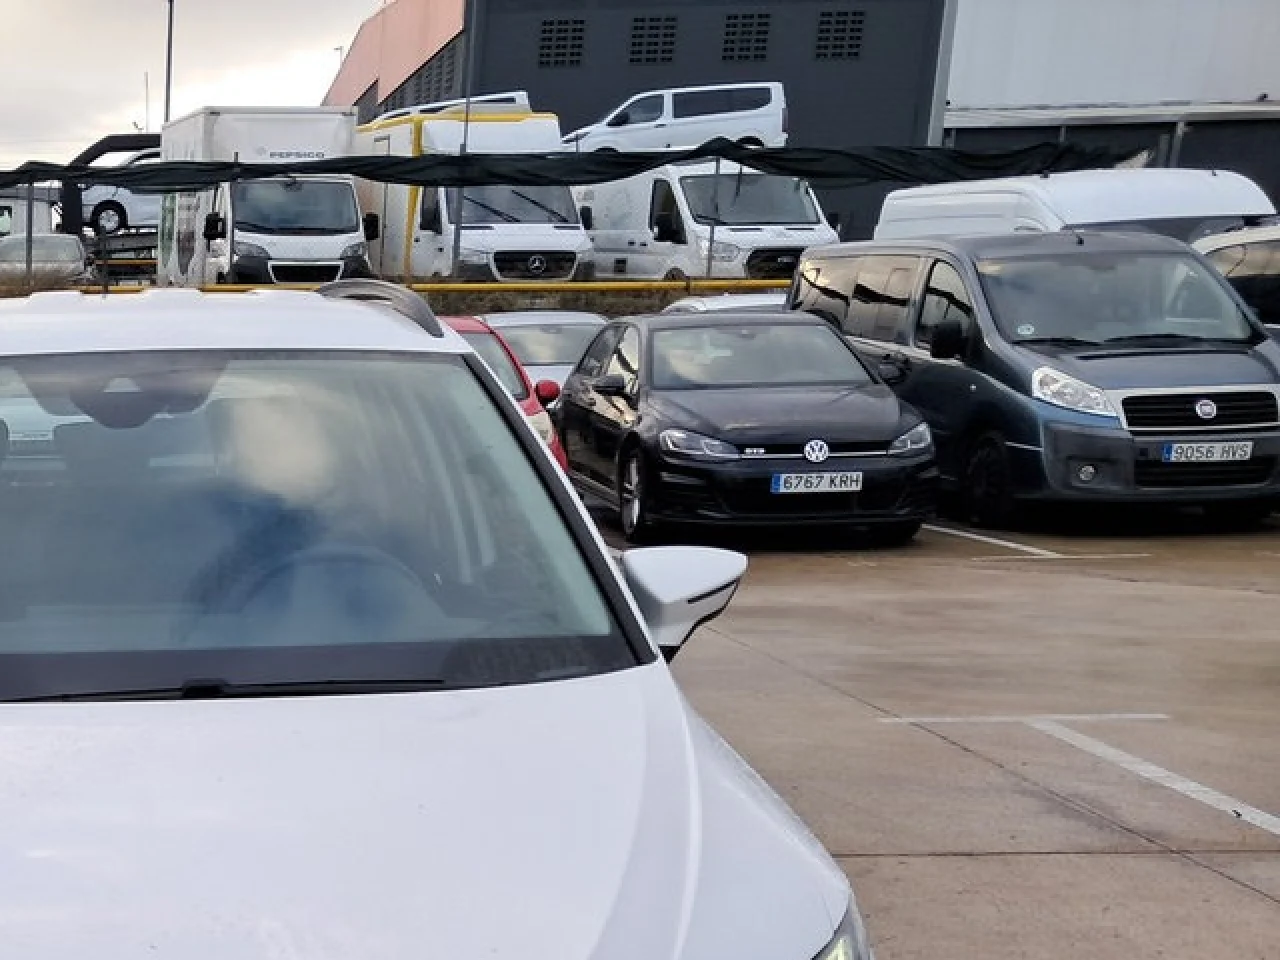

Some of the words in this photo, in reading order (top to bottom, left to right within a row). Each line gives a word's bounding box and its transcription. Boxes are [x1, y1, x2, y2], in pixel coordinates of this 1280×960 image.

[1174, 445, 1215, 460] 9056
[783, 475, 825, 490] 6767
[829, 473, 861, 489] KRH
